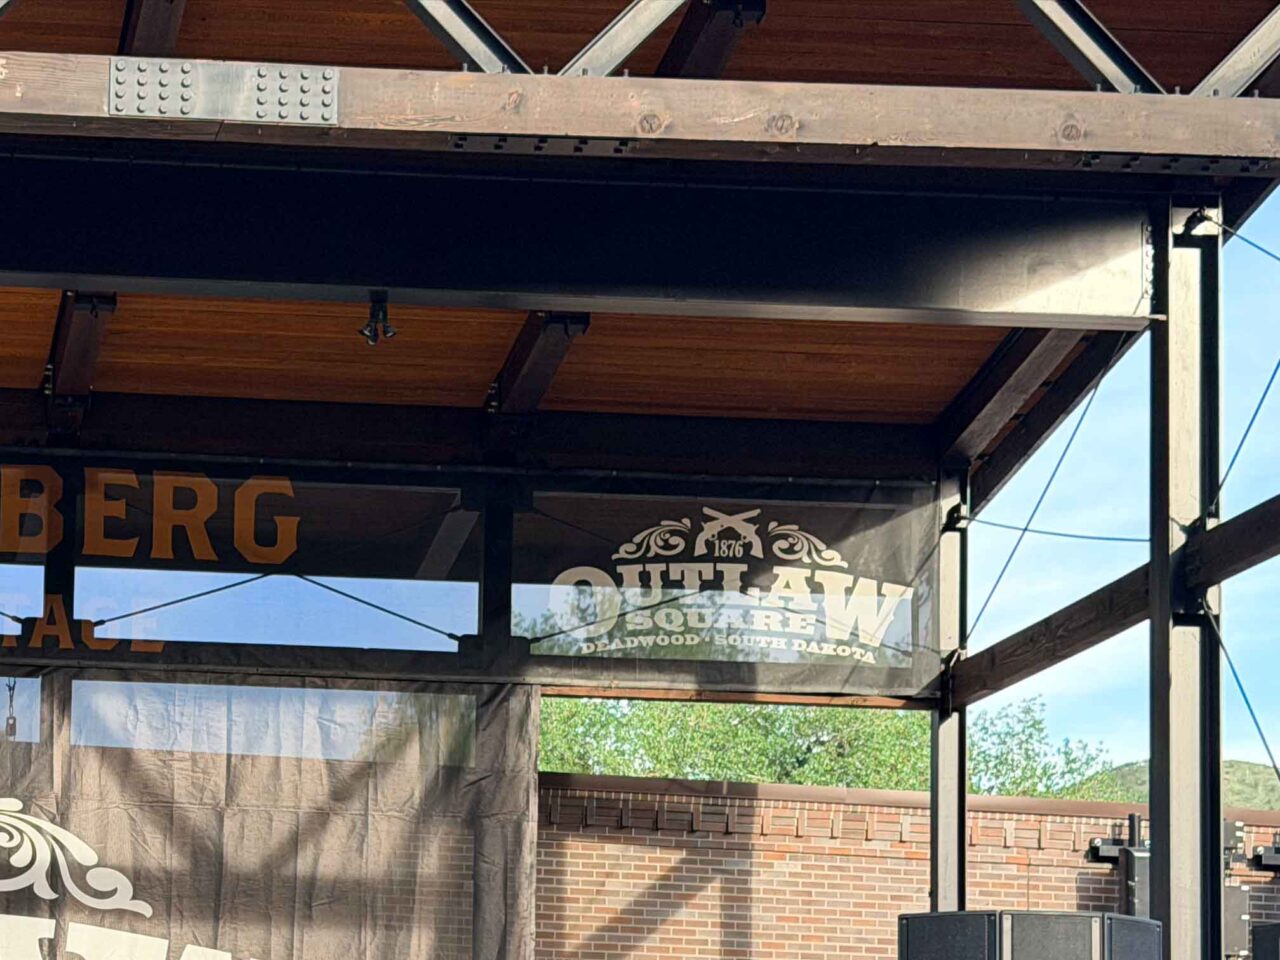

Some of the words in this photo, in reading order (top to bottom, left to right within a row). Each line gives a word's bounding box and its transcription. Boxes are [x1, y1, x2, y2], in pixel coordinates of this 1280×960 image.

[713, 538, 744, 558] 1876
[547, 562, 913, 648] OUTLAW
[626, 608, 816, 634] SQUARE
[582, 634, 700, 654] DEADWOOD
[715, 634, 787, 649] SOUTH
[791, 639, 876, 663] DAKOTA
